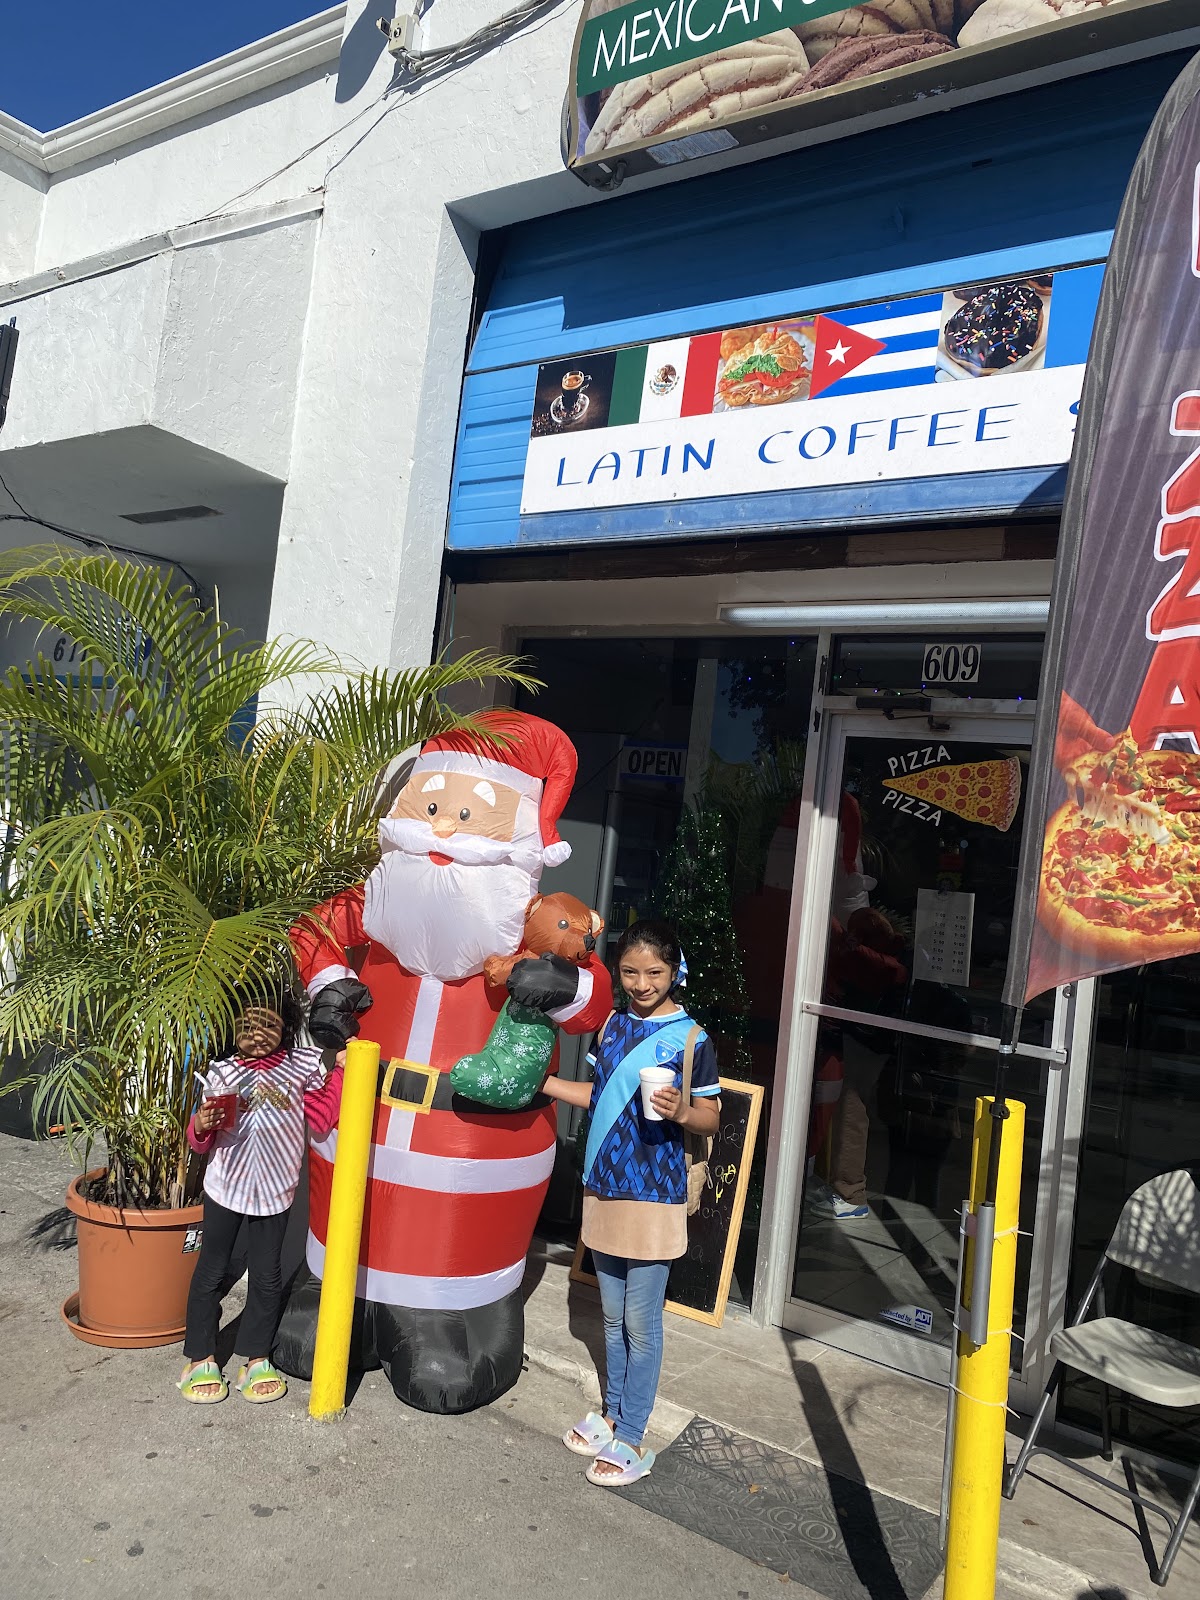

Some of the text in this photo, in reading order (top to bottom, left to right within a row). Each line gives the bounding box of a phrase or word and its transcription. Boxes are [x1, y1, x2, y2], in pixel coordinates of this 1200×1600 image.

[556, 437, 717, 488] LATIN
[757, 402, 1022, 465] COFFEE
[924, 645, 979, 681] 609
[628, 749, 682, 776] OPEN
[887, 744, 952, 777] PIZZA
[881, 789, 942, 827] PIZZA
[915, 1311, 931, 1325] ADT
